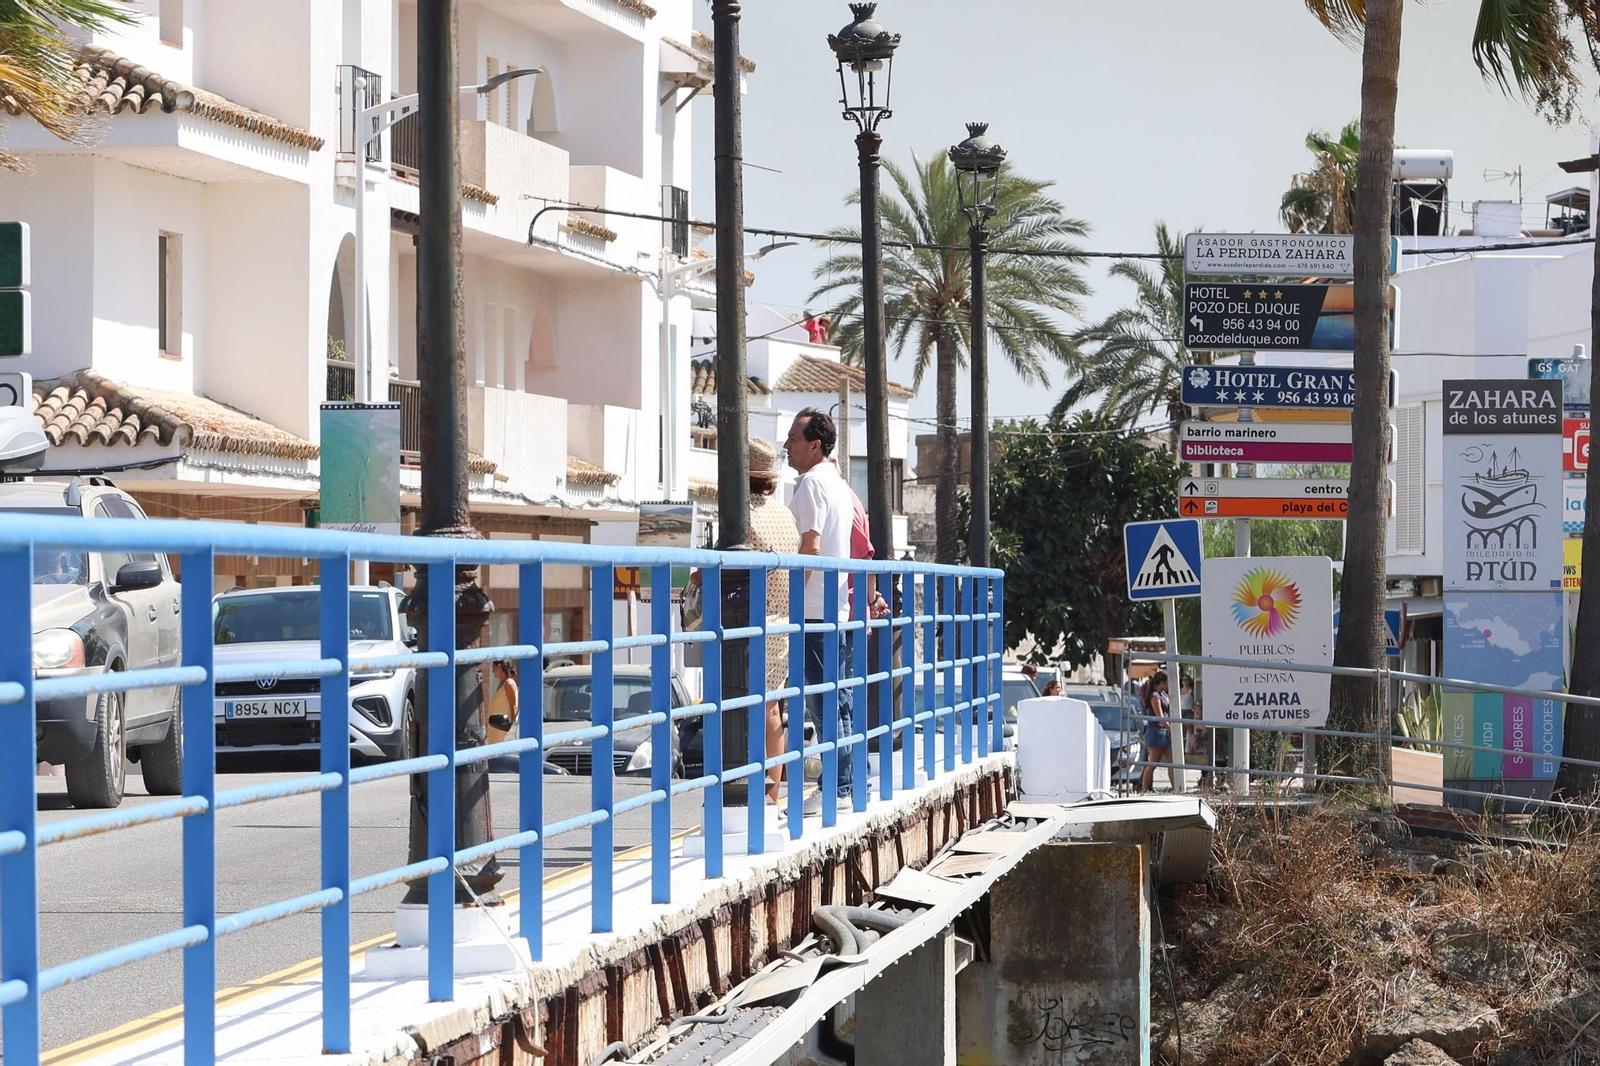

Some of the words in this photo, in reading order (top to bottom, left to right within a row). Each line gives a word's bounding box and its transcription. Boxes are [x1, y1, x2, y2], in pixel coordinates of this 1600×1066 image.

[1196, 238, 1244, 246] ASADOR
[1250, 239, 1346, 248] GASTRONÓMICO
[1196, 248, 1214, 258] LA
[1219, 248, 1281, 258] PERDIDA
[1286, 249, 1345, 260] ZAHARA
[1190, 287, 1230, 299] HOTEL
[1190, 302, 1225, 313] POZO
[1228, 302, 1251, 314] DEL
[1255, 303, 1300, 316] DUQUE
[1222, 319, 1244, 330] 956
[1248, 319, 1263, 330] 43
[1267, 319, 1281, 330] 94
[1285, 320, 1300, 330] 00
[1188, 333, 1299, 346] pozodelduque.com
[1214, 370, 1282, 388] HOTEL
[1287, 372, 1345, 390] GRAN
[1278, 392, 1300, 403] 956
[1304, 392, 1319, 404] 43
[1324, 392, 1339, 404] 93
[1449, 390, 1556, 408] ZAHARA
[1449, 412, 1468, 424] de
[1474, 412, 1497, 424] los
[1502, 413, 1556, 424] atunes
[1187, 427, 1221, 437] barrio
[1225, 428, 1276, 438] marinero
[1187, 445, 1244, 456] biblioteca
[1305, 484, 1342, 494] centro
[1282, 502, 1312, 514] playa
[1317, 502, 1335, 512] del
[1466, 558, 1537, 581] ATÚN
[1240, 644, 1295, 655] PUEBLOS
[1254, 672, 1295, 683] ESPAÑA
[1234, 692, 1301, 706] ZAHARA
[235, 703, 268, 716] 8954
[274, 702, 300, 714] NCX
[1226, 710, 1239, 719] de
[1243, 710, 1259, 719] los
[1263, 709, 1310, 719] ATUNES
